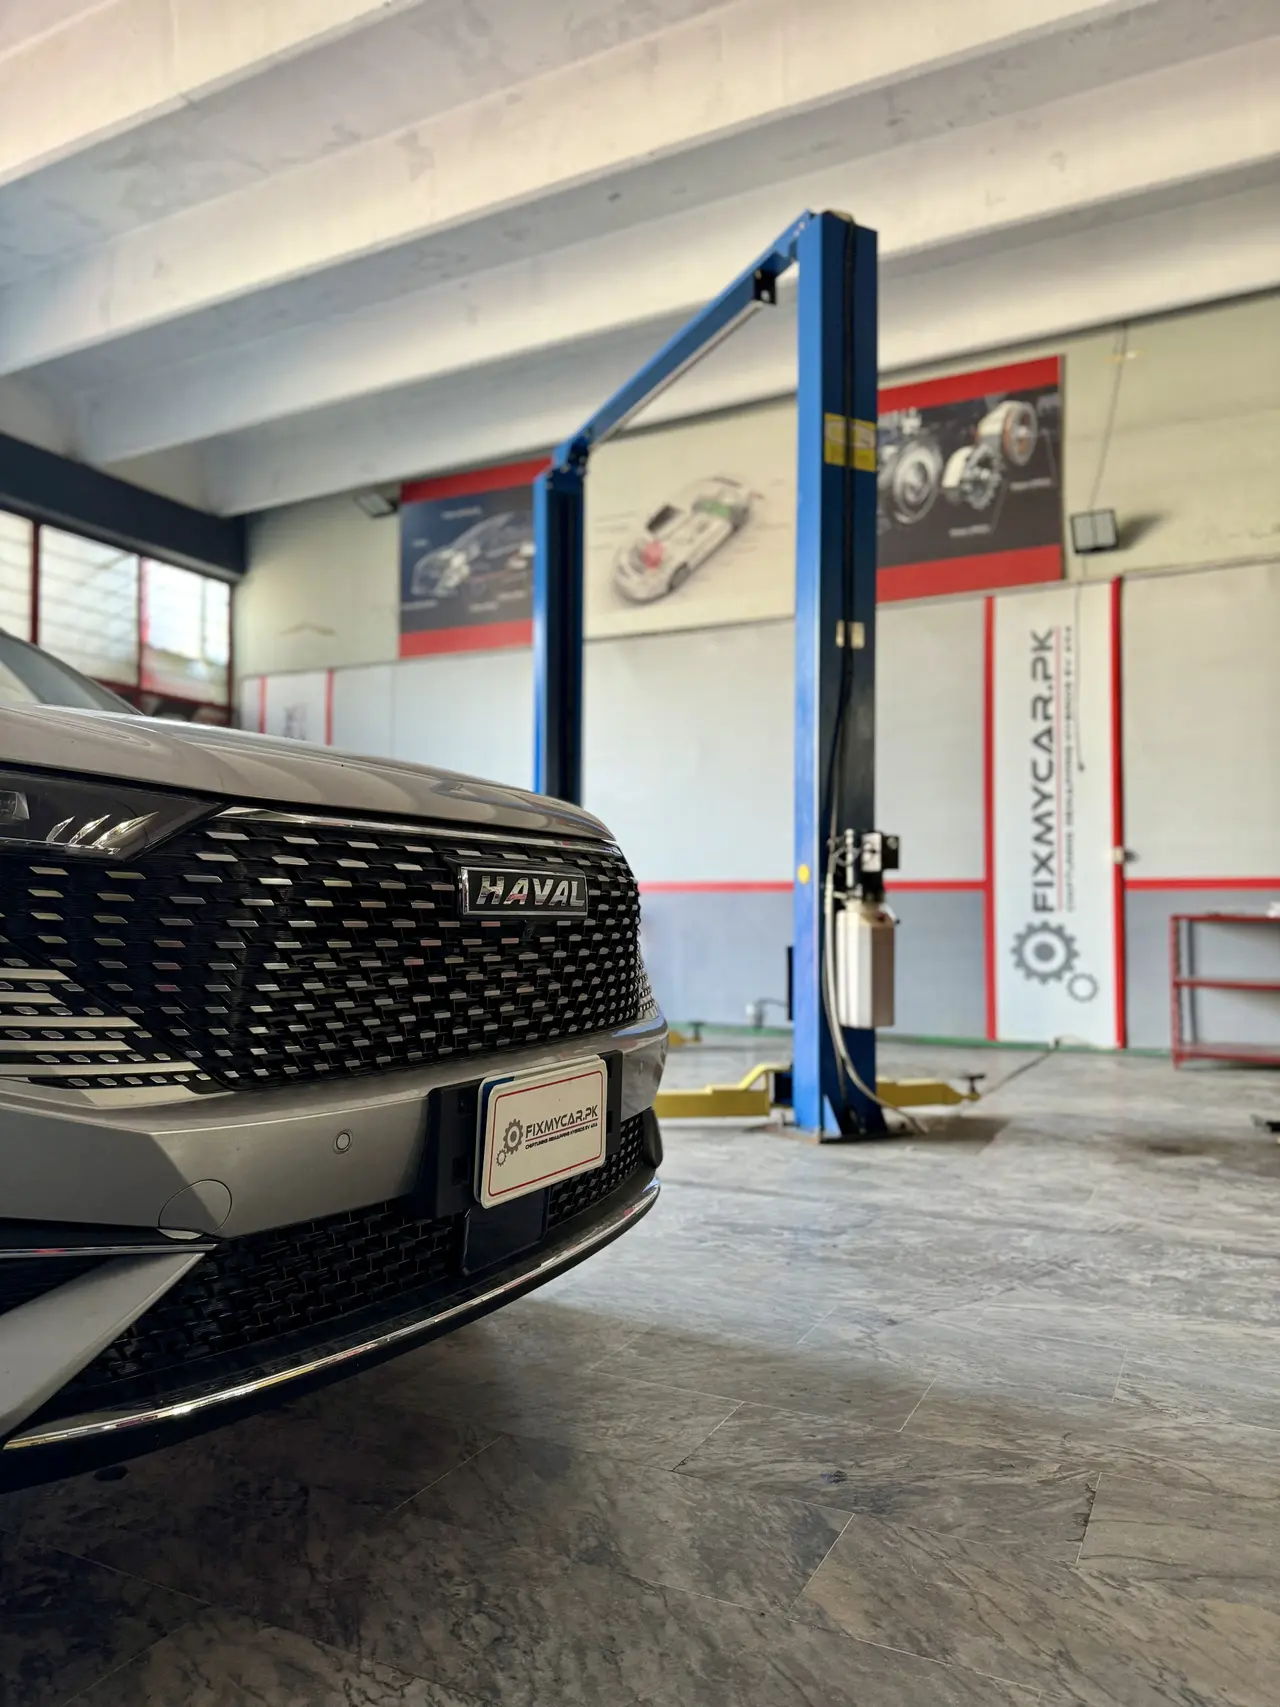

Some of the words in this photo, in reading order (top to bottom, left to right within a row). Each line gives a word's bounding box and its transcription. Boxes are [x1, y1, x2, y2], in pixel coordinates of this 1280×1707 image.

[1031, 626, 1054, 912] FIXMYCAR.PK
[475, 875, 585, 907] HAVAL
[525, 1105, 598, 1139] FIXMYCAR.PK
